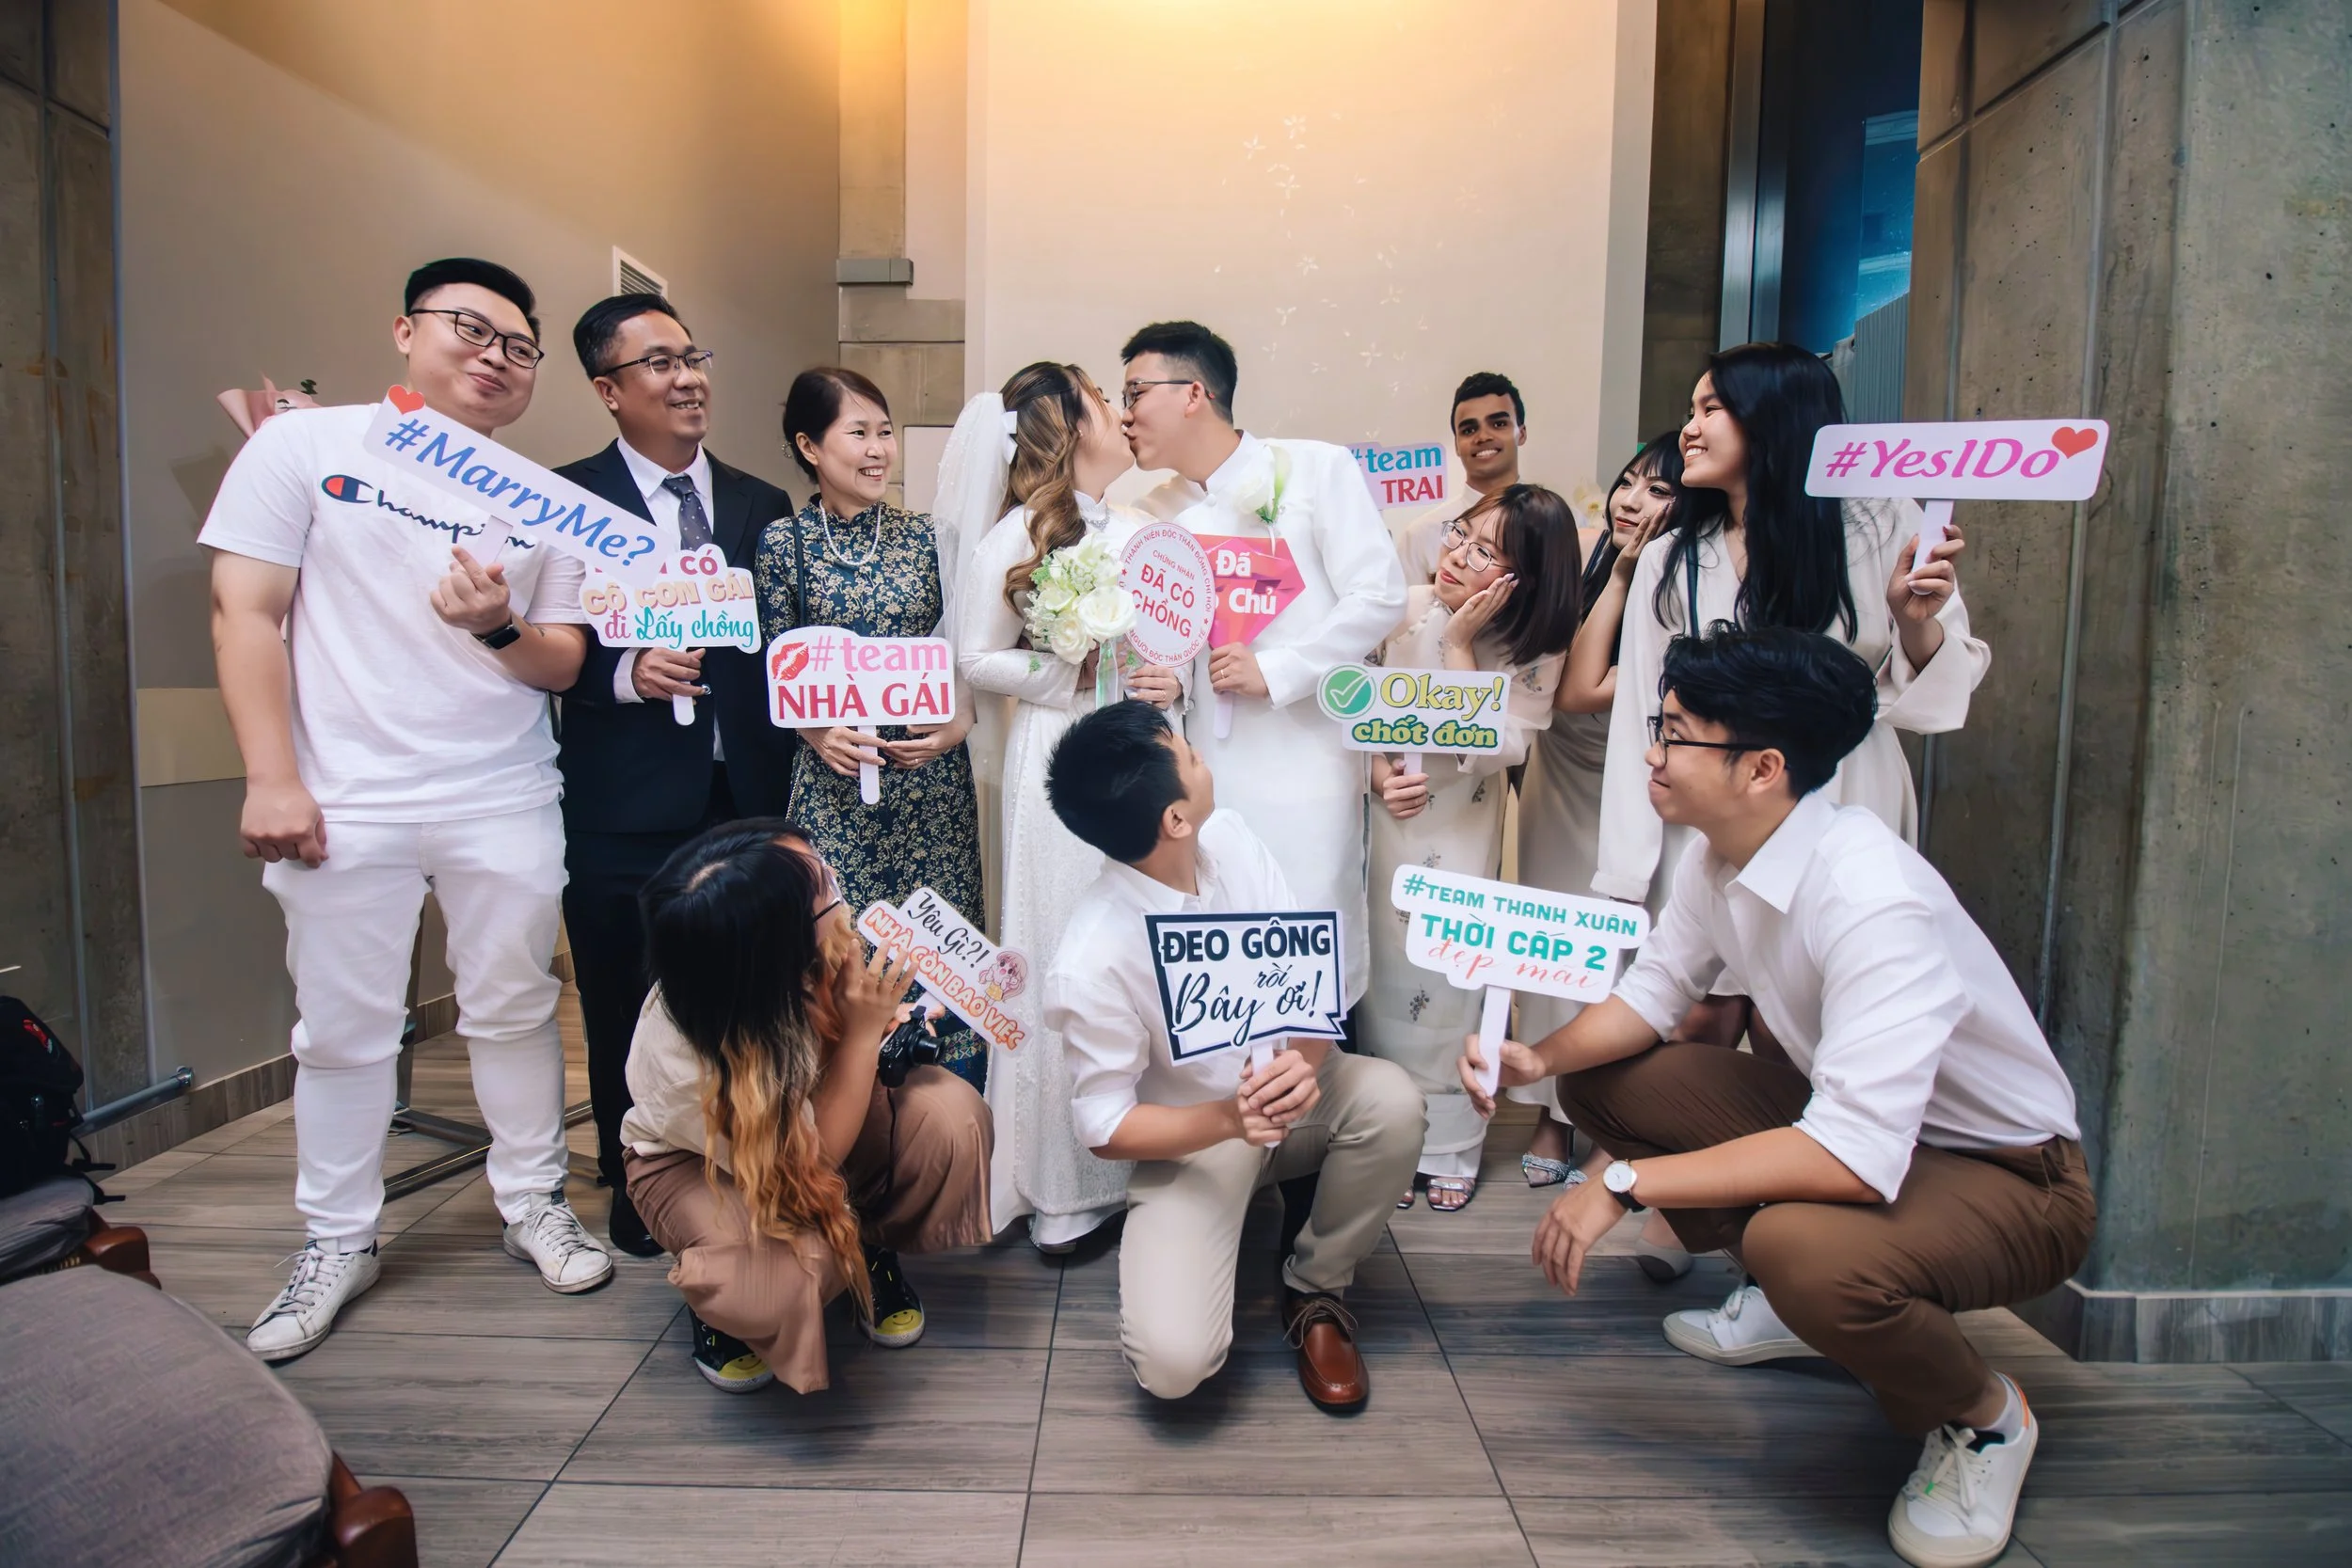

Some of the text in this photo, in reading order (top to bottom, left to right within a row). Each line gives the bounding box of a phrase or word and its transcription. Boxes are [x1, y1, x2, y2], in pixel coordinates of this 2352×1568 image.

[1825, 437, 2059, 479] #YesIDo
[321, 474, 535, 549] Champin
[385, 419, 655, 566] #MarryMe?
[1380, 475, 1443, 503] TRAI
[1140, 563, 1167, 593] ĐÃ
[1170, 582, 1195, 608] CÓ
[1216, 549, 1251, 578] Đã
[583, 574, 755, 616] CÔ CON GÁI
[1132, 589, 1192, 639] CHỒNG
[1229, 586, 1277, 615] Chủ
[605, 606, 755, 649] đi Lấy chồng
[809, 634, 947, 673] #team
[777, 672, 949, 720] NHÀ GÁI
[1380, 672, 1503, 721] Okay!
[1352, 714, 1499, 749] chốt đơn
[907, 891, 946, 937] Yêu
[1402, 873, 1637, 937] #TEAM THANH XUÂN
[1161, 919, 1330, 963] ĐEO GÔNG
[1421, 912, 1608, 971] THỜI CẤP 2
[1427, 937, 1600, 989] đẹp mãi
[909, 945, 952, 987] CÒN
[944, 975, 987, 1017] BAO
[983, 1007, 1025, 1051] VIỆC
[1174, 972, 1265, 1047] Bây
